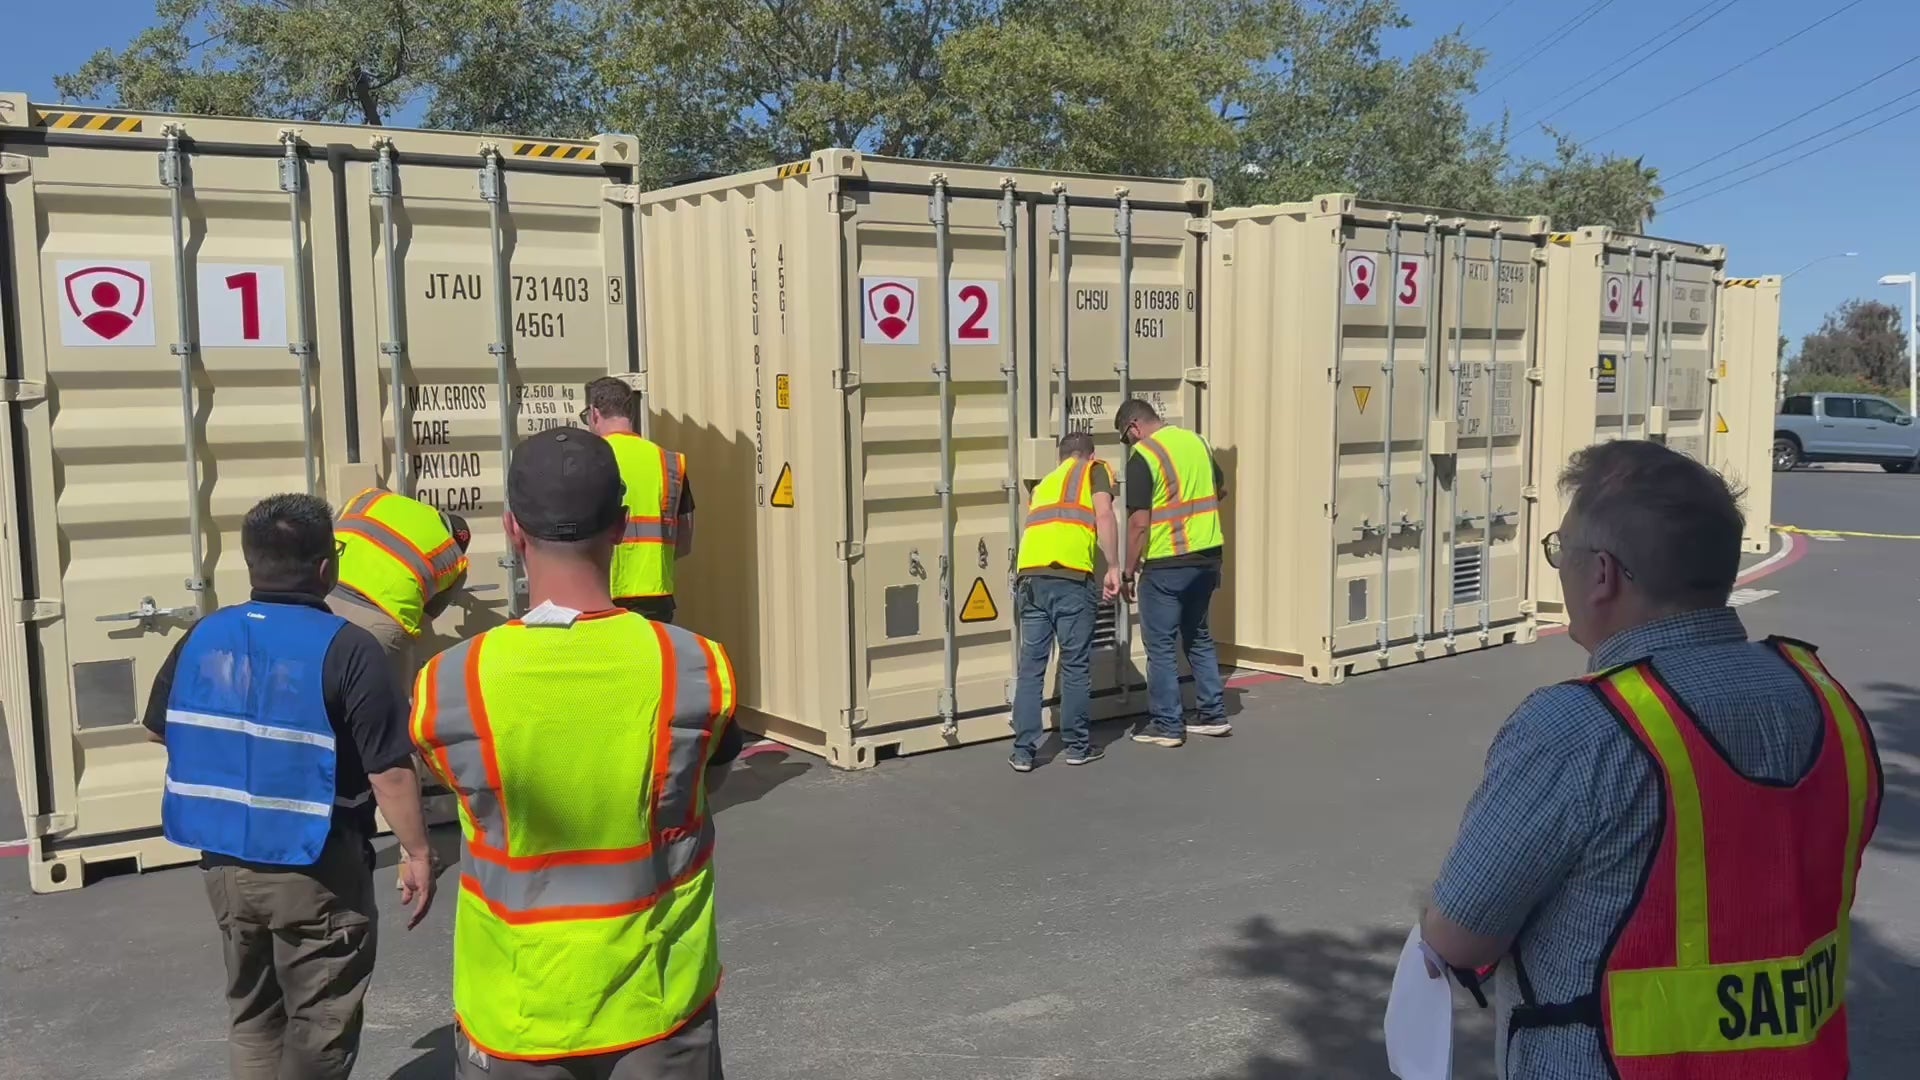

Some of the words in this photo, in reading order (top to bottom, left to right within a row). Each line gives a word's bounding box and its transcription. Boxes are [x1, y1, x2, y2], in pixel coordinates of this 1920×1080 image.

[425, 273, 482, 300] JTAU
[512, 275, 589, 302] 731403
[610, 278, 622, 303] 3
[750, 247, 760, 336] CHSU
[777, 243, 787, 335] 45G1
[1398, 261, 1418, 305] 3
[1632, 279, 1644, 315] 4
[224, 271, 260, 340] 1
[958, 285, 989, 339] 2
[1076, 289, 1109, 311] CHSU
[1134, 289, 1180, 311] 816936
[1186, 290, 1194, 311] 0
[515, 312, 565, 338] 45G1
[1134, 317, 1164, 338] 45G1
[408, 385, 487, 412] MAX.GROSS
[516, 385, 554, 399] 32.500
[562, 385, 574, 400] kg
[517, 402, 556, 414] 71.650
[563, 402, 574, 413] lb
[753, 344, 764, 474] 816936
[413, 420, 450, 446] TARE
[413, 452, 481, 480] PAYLOAD
